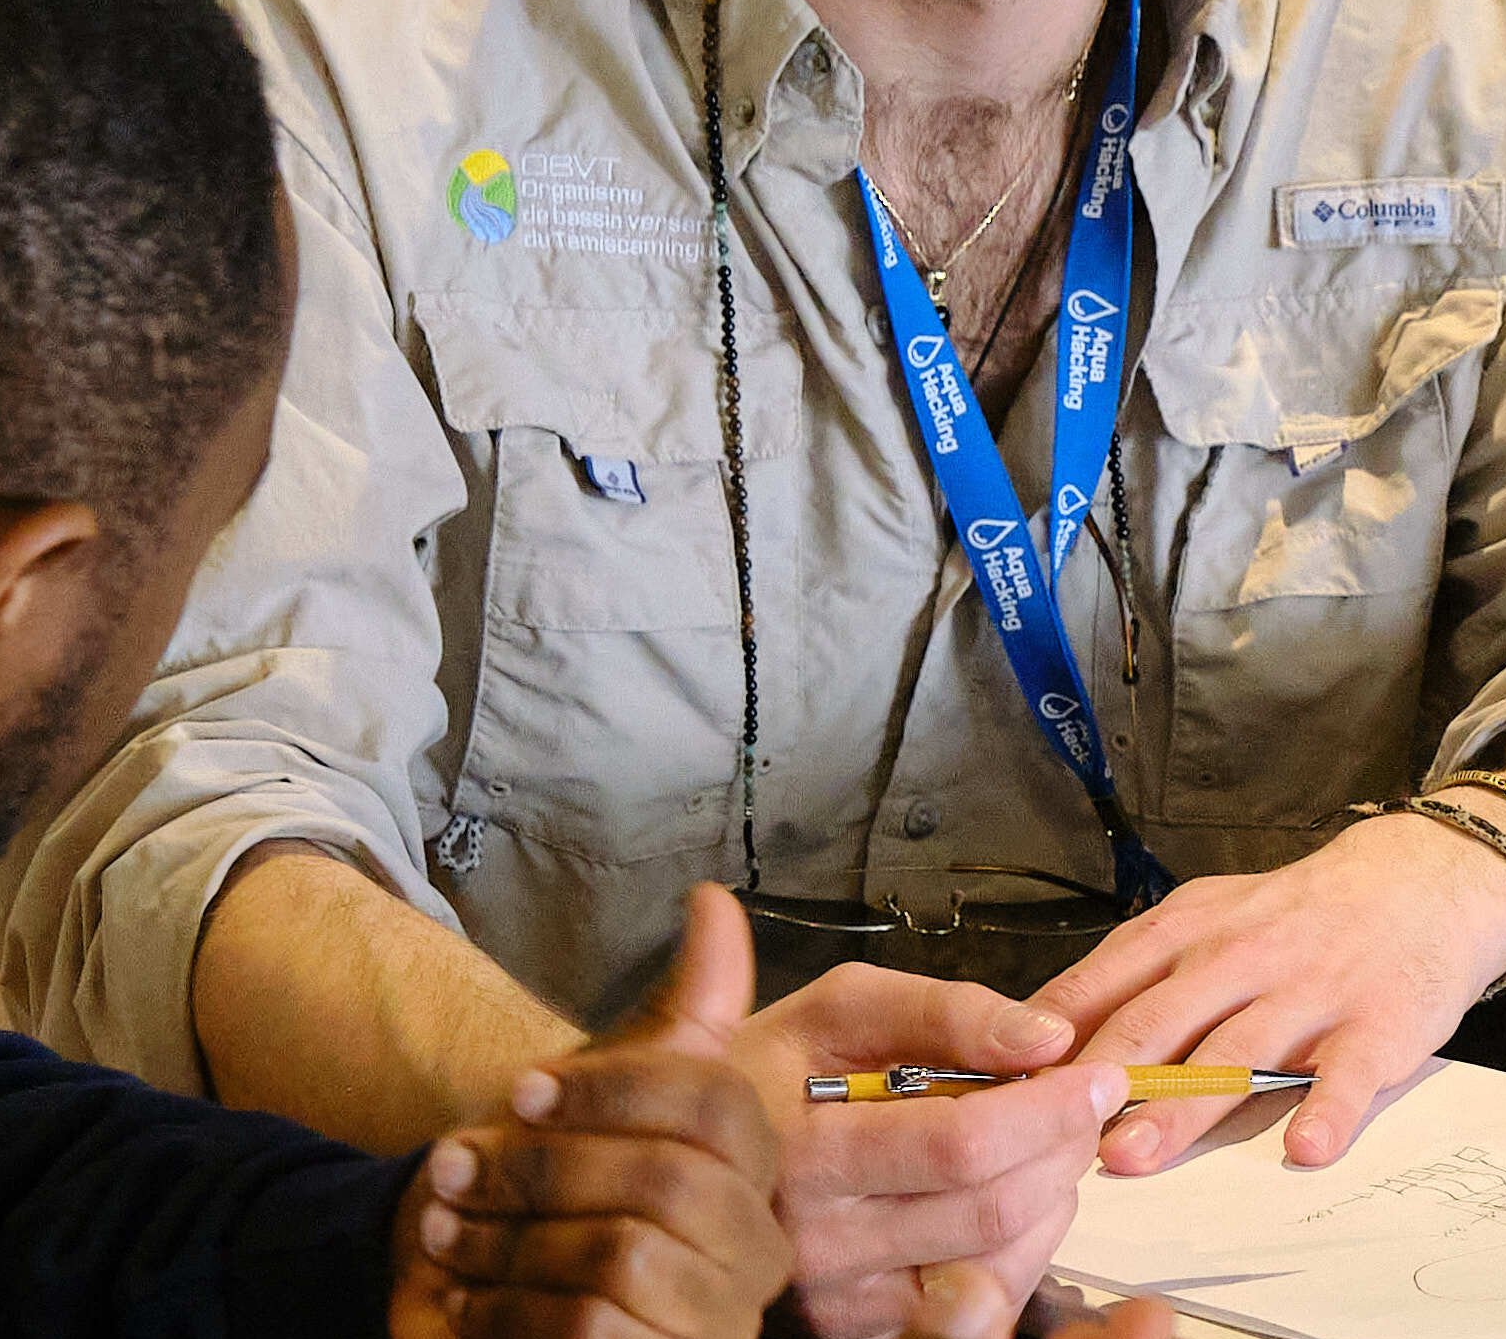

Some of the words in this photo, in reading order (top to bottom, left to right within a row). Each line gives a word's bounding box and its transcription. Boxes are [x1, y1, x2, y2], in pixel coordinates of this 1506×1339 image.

[1082, 137, 1116, 220] Hacking
[1338, 198, 1436, 220] Columbia
[940, 363, 968, 417] Aqua
[1063, 324, 1086, 411] Hacking
[1089, 325, 1114, 384] Aqua
[919, 367, 960, 455] Hacking
[981, 549, 1023, 633] Hacking
[1002, 546, 1034, 600] Aqua
